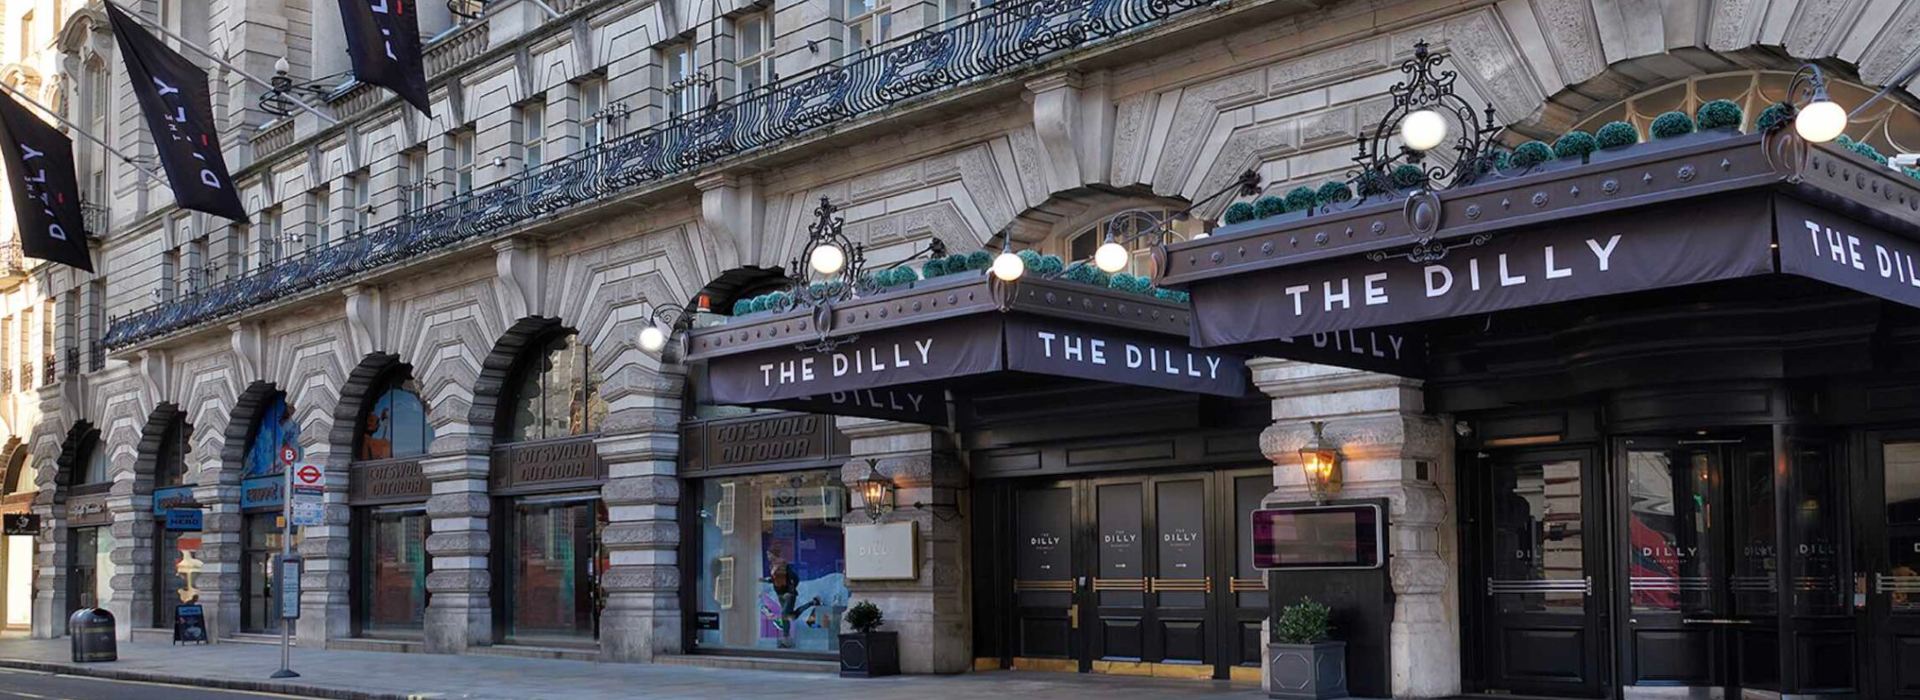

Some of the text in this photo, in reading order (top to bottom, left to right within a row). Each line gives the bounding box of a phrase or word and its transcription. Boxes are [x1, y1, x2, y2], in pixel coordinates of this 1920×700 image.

[153, 76, 221, 189] DILY
[1804, 220, 1865, 271] THE
[1286, 235, 1621, 316] THE DILLY
[760, 339, 934, 387] THE DILLY
[1038, 332, 1221, 380] THE DILLY
[716, 415, 818, 443] COTSWOLD
[285, 449, 294, 460] B
[722, 438, 810, 463] OUTDOOR
[1030, 537, 1061, 545] DILLY
[1104, 534, 1137, 543] DILLY
[1164, 532, 1198, 542] DILLY
[1642, 546, 1698, 557] DILLY
